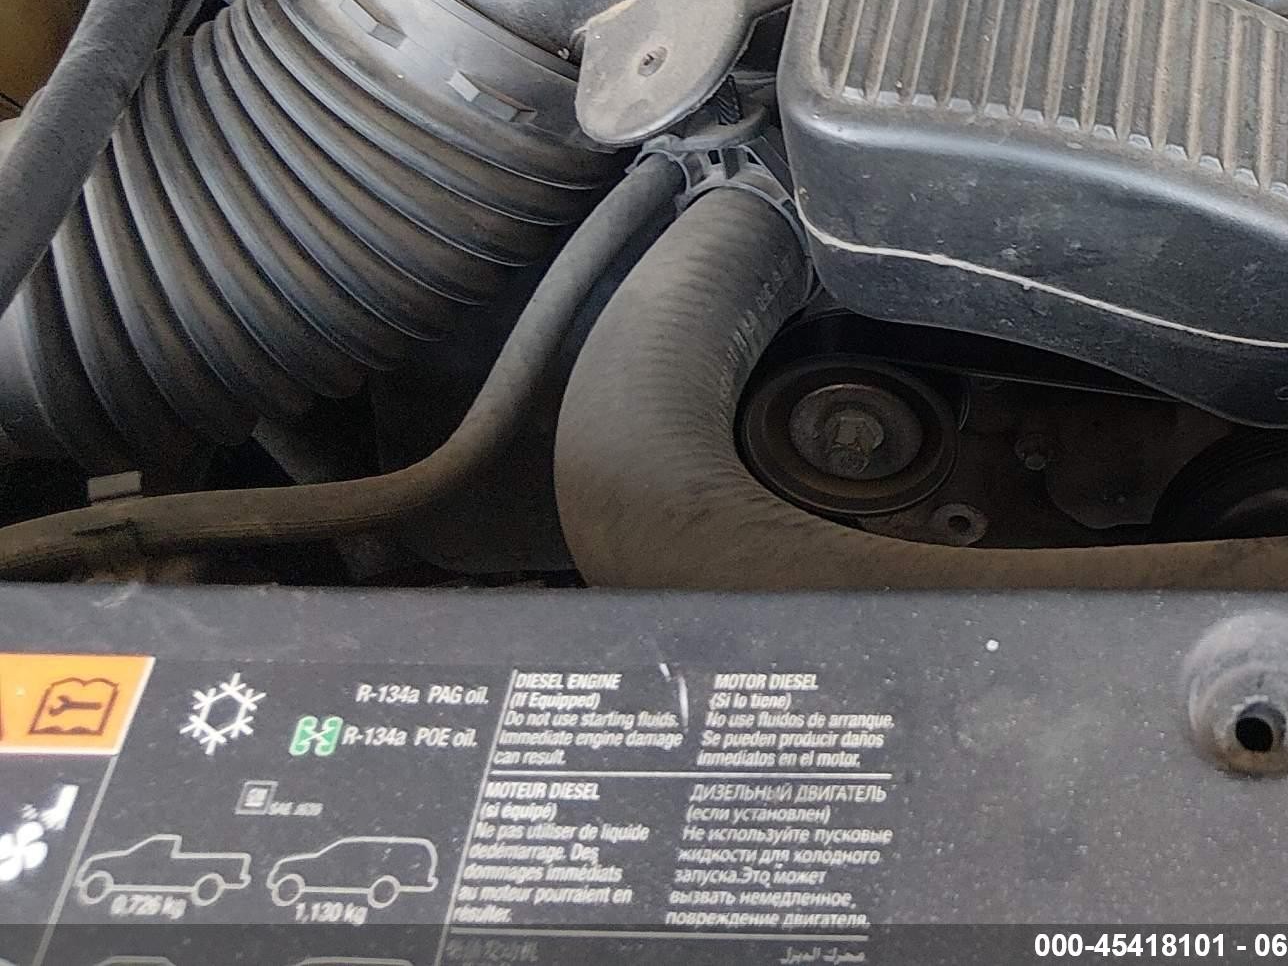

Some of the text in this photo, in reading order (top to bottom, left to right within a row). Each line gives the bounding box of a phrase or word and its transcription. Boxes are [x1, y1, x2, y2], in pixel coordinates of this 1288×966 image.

[514, 673, 622, 690] DIESEL ENGINE
[714, 673, 819, 690] MOTOR DIESEL
[355, 684, 489, 704] R-134a PAG oil.
[529, 692, 600, 710] Equipped)
[709, 692, 792, 711] (Si lo tiene)
[504, 711, 680, 730] Do not use starting fluids.
[705, 711, 726, 727] No
[728, 713, 755, 728] use
[757, 711, 805, 728] fluidos
[807, 712, 826, 728] de
[341, 725, 478, 747] R-134a POE oil.
[499, 729, 684, 750] Immediate engine damage
[702, 729, 885, 750] Se pueden producir daños
[493, 749, 567, 765] can result.
[778, 752, 798, 767] en
[799, 750, 814, 767] el
[816, 751, 861, 768] motor.
[485, 782, 600, 801] MOTEUR DIESEL
[689, 783, 888, 803] ДИЗЕЛЬНЫЙ ДВИГАТЕЛЬ
[686, 806, 831, 825] (если установлен)
[473, 822, 496, 839] Ne
[496, 824, 525, 841] pas
[578, 823, 599, 841] de
[600, 823, 650, 844] liquide
[682, 825, 894, 846] Не используйте пусковые
[758, 849, 790, 864] для
[793, 849, 881, 866] холодного
[457, 885, 479, 901] au
[479, 884, 533, 903] moteur
[533, 886, 611, 905] pourraient
[669, 890, 737, 906] вызвать
